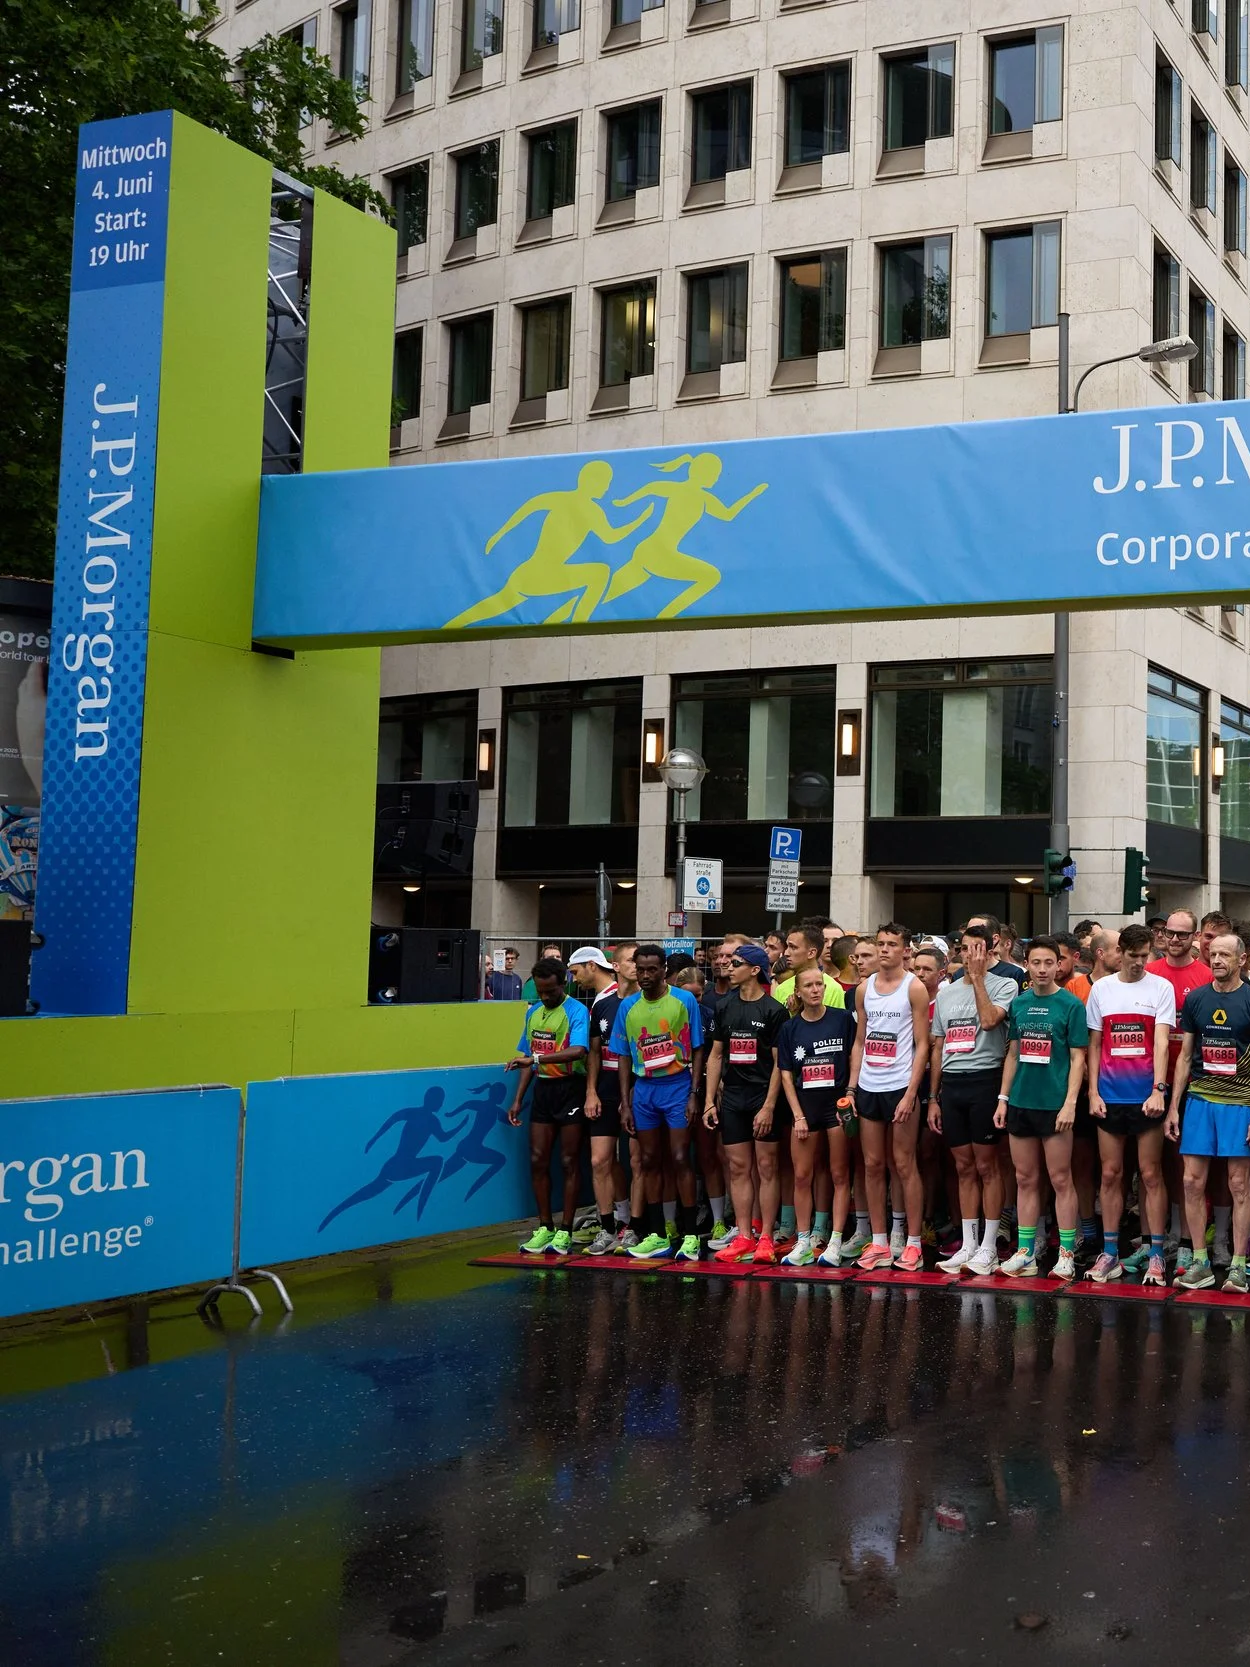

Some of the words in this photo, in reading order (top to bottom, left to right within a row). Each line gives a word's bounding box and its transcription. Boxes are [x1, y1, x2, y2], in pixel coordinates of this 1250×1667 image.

[82, 137, 167, 169] Mittwoch
[92, 180, 109, 200] 4.
[115, 175, 153, 197] Juni
[94, 209, 147, 233] Start:
[89, 246, 109, 267] 19
[113, 240, 149, 264] Uhr
[776, 831, 792, 855] P
[662, 939, 694, 949] Notfalltor
[813, 1038, 843, 1048] POLIZEI
[1112, 1034, 1144, 1044] 11088
[532, 1040, 554, 1051] 0613
[644, 1042, 673, 1056] 10612
[866, 1042, 895, 1052] 10757
[1021, 1041, 1049, 1051] 10997
[1204, 1049, 1234, 1059] 11685
[803, 1066, 832, 1077] 11951
